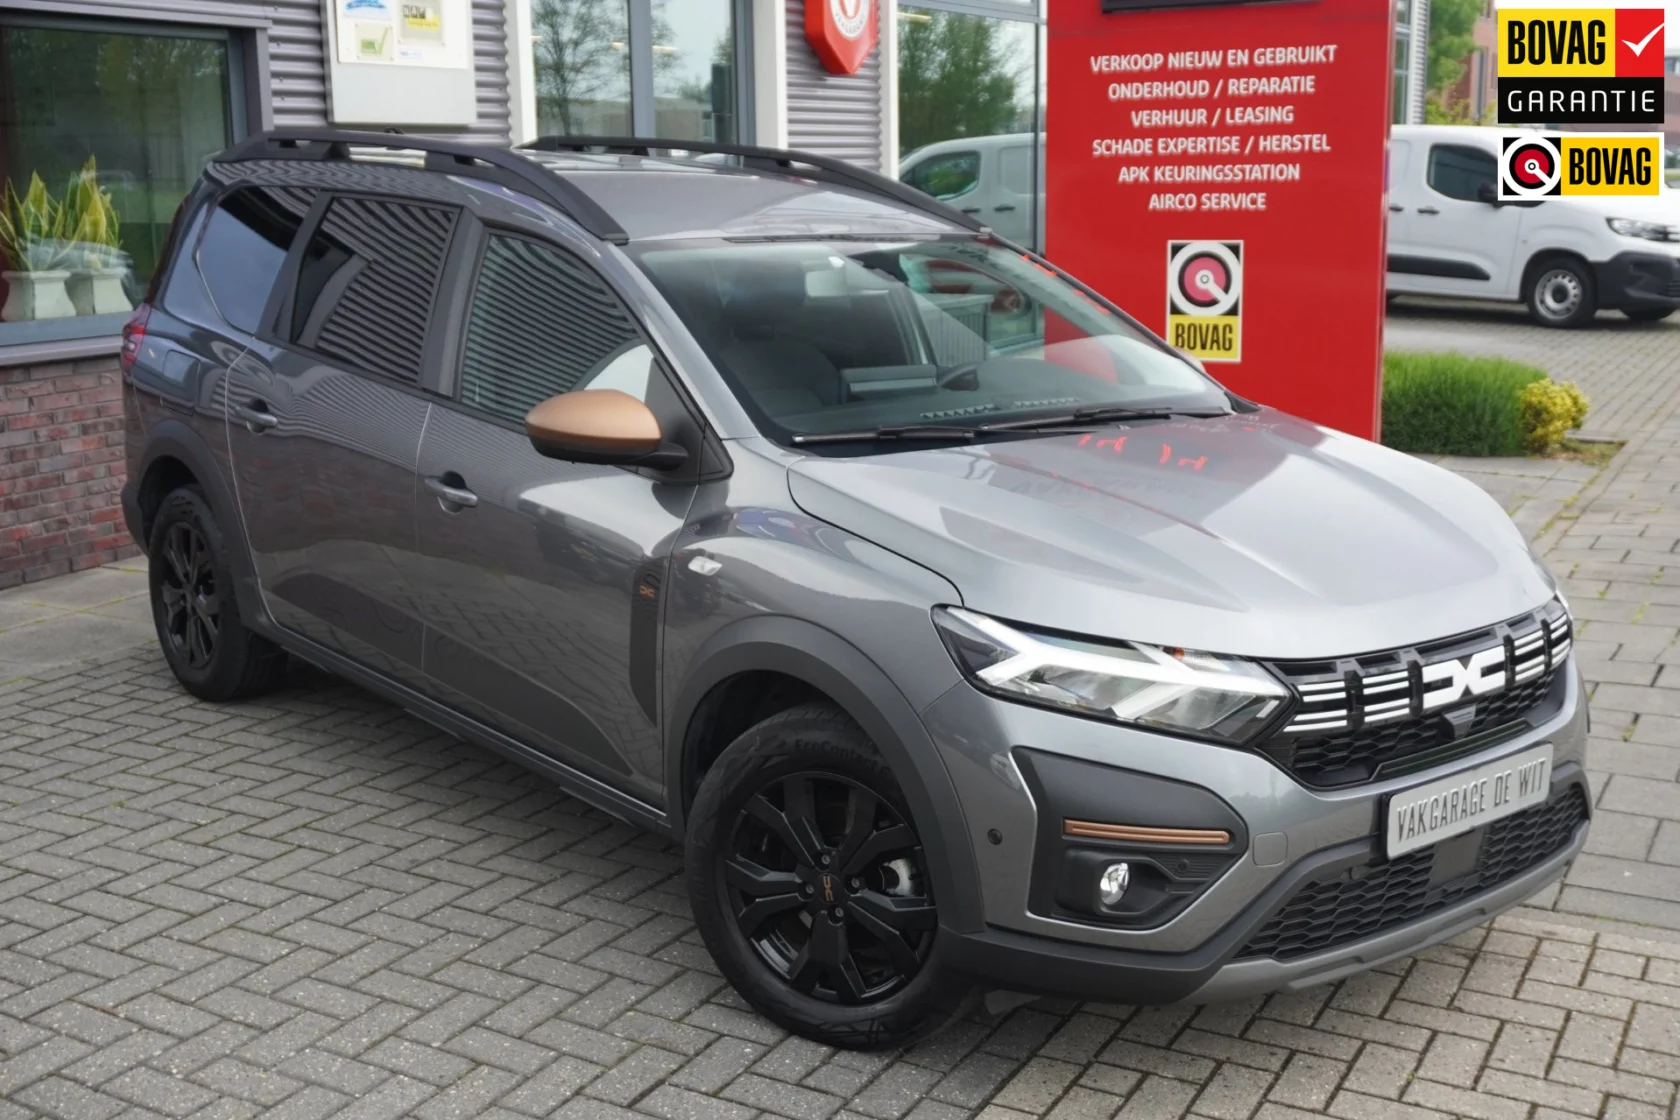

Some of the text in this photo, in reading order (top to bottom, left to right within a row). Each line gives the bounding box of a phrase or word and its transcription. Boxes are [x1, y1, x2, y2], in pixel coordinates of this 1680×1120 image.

[1091, 45, 1337, 72] VERKOOP NIEUW EN GEBRUIKT
[1108, 80, 1209, 100] ONDERHOUD
[1228, 76, 1315, 95] REPARATIE
[1131, 109, 1207, 127] VERHUUR
[1226, 106, 1293, 124] LEASING
[1093, 138, 1152, 156] SCHADE
[1158, 136, 1240, 154] EXPERTISE
[1259, 134, 1331, 152] HERSTEL
[1119, 164, 1300, 182] APK KEURINGSSTATION
[1149, 193, 1266, 210] AIRCO SERVICE
[1174, 322, 1233, 351] BOVAG
[1397, 757, 1547, 842] VAKGARAGE DE WIT
